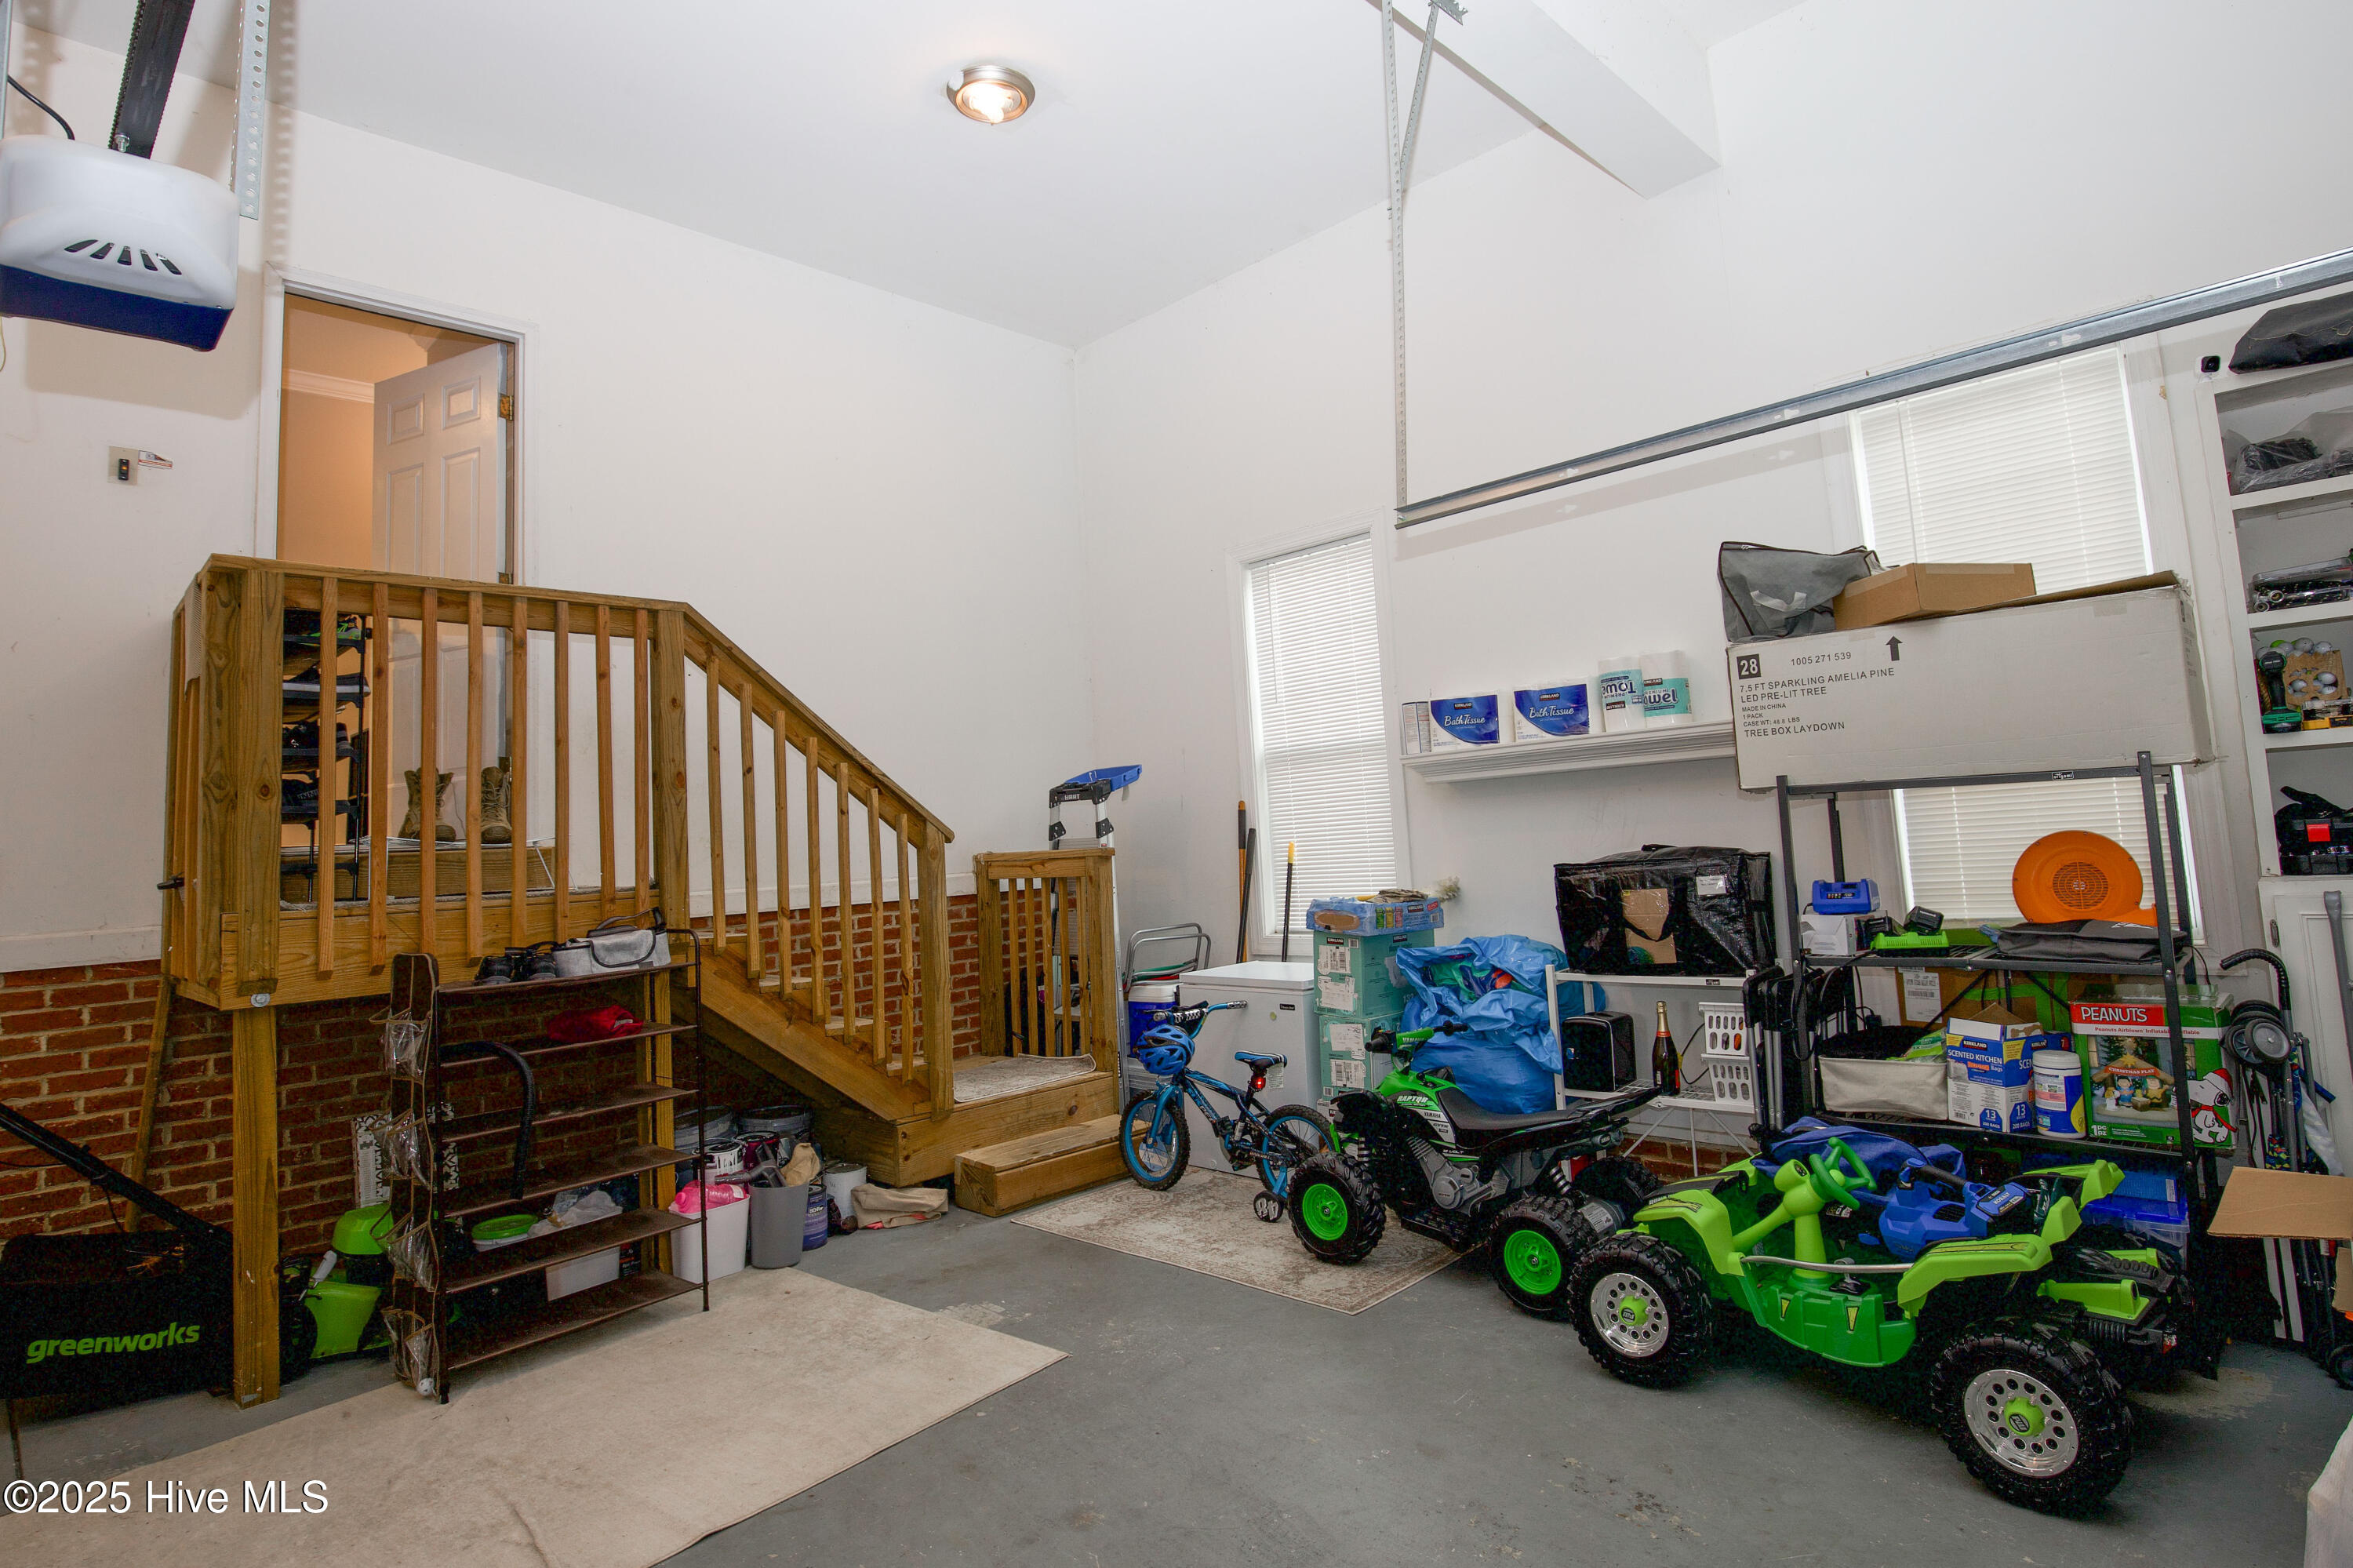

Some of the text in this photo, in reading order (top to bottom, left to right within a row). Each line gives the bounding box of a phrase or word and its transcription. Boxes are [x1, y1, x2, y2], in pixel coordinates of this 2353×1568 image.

[1791, 651, 1852, 666] 1005 271 539
[1740, 658, 1758, 675] 28
[1740, 668, 1895, 693] 7.5 FT SPARKLING AMELIA PINE
[1601, 681, 1636, 696] Towe
[1740, 686, 1827, 704] LED PRE-LIT TREE
[1644, 689, 1678, 705] owel
[1529, 705, 1575, 719] Bath Tissue
[1444, 714, 1486, 726] Bath Tissue
[1744, 722, 1845, 737] TREE BOX LAYDOWN
[2081, 1006, 2148, 1022] PEANUTS
[1963, 1040, 1987, 1049] KIRKLAND
[1947, 1050, 2002, 1064] SCENTED KITCHEN
[2019, 1059, 2033, 1070] SCEN
[1396, 1095, 1428, 1104] RAPTOR
[1985, 1109, 1996, 1119] 13
[2016, 1104, 2026, 1116] 13
[2091, 1125, 2098, 1137] 1
[26, 1322, 201, 1364] greenworks
